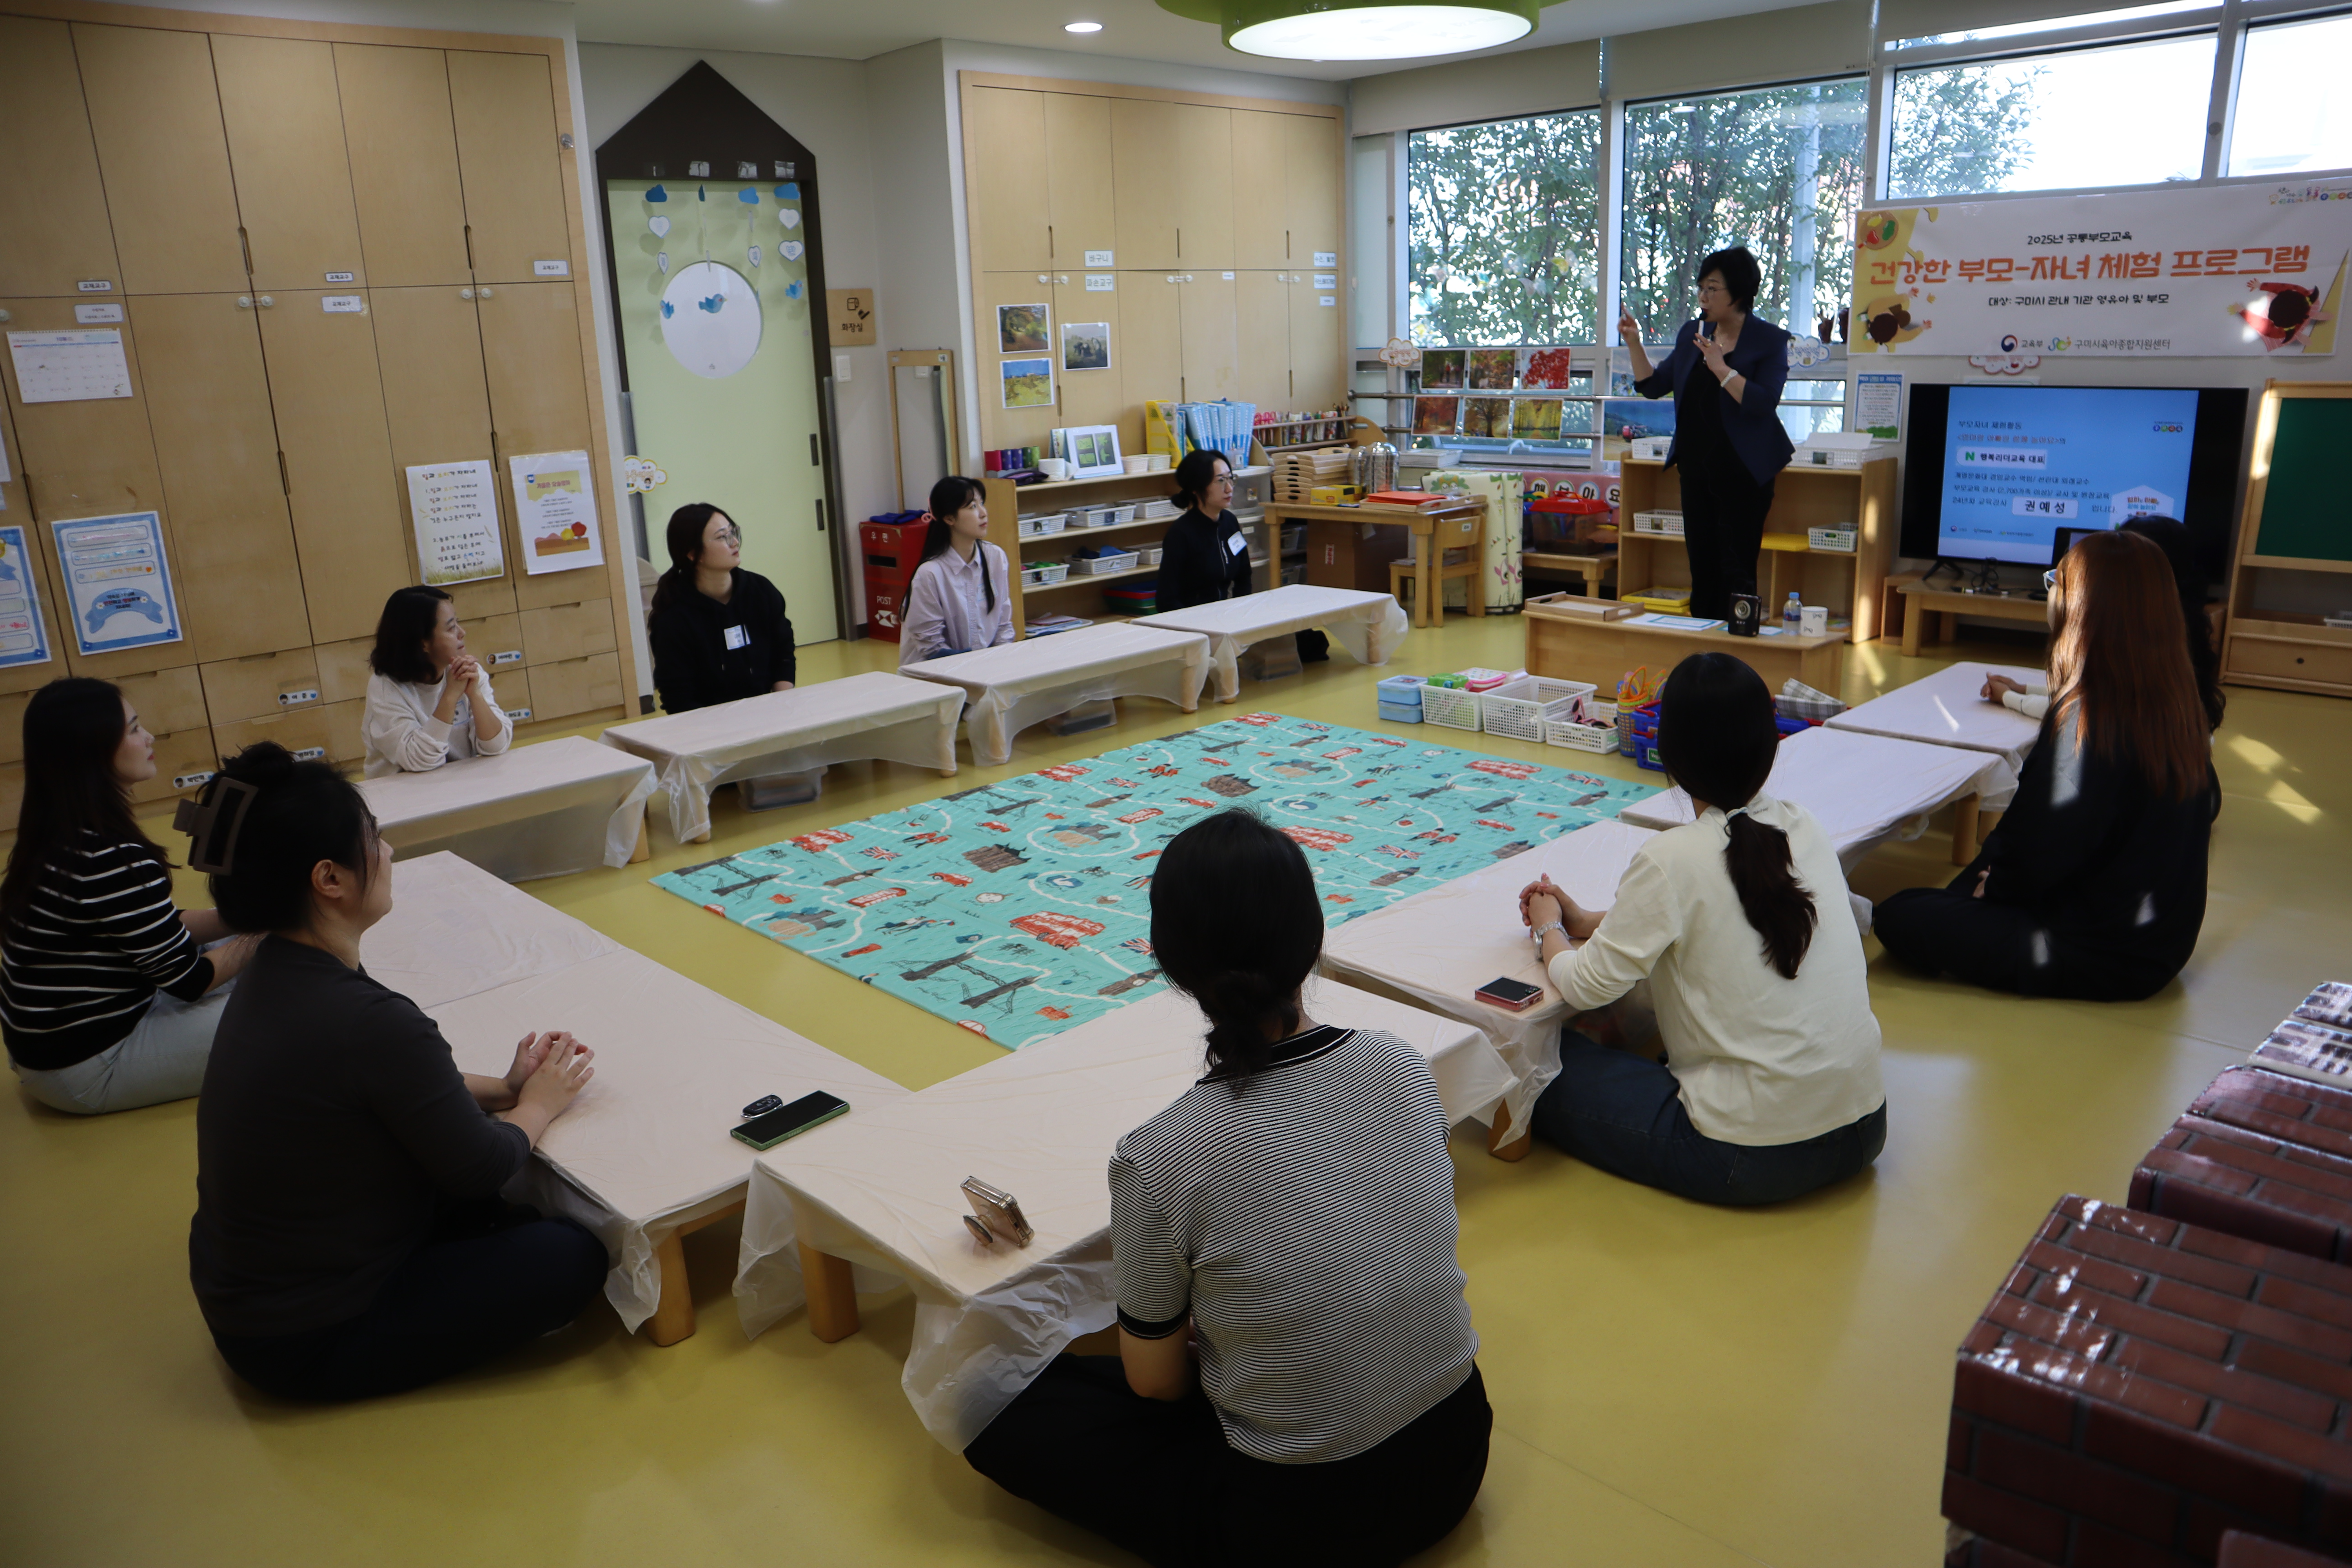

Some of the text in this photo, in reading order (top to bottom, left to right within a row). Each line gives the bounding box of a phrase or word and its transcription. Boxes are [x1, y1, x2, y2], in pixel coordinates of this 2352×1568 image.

[2027, 235, 2063, 245] 2025년
[1871, 245, 2310, 284] 건강한 부모-자녀 체험 프로그램
[2015, 296, 2045, 305] 구미시
[2048, 296, 2069, 305] 관내
[2076, 296, 2093, 305] 기관
[2097, 295, 2129, 304] 영유아
[2133, 295, 2143, 303] 및
[2147, 294, 2169, 303] 부모
[842, 323, 862, 332] 화장실
[1980, 453, 2043, 464] 행복리더교육 대표
[871, 531, 888, 543] 우 편
[877, 595, 891, 605] POST
